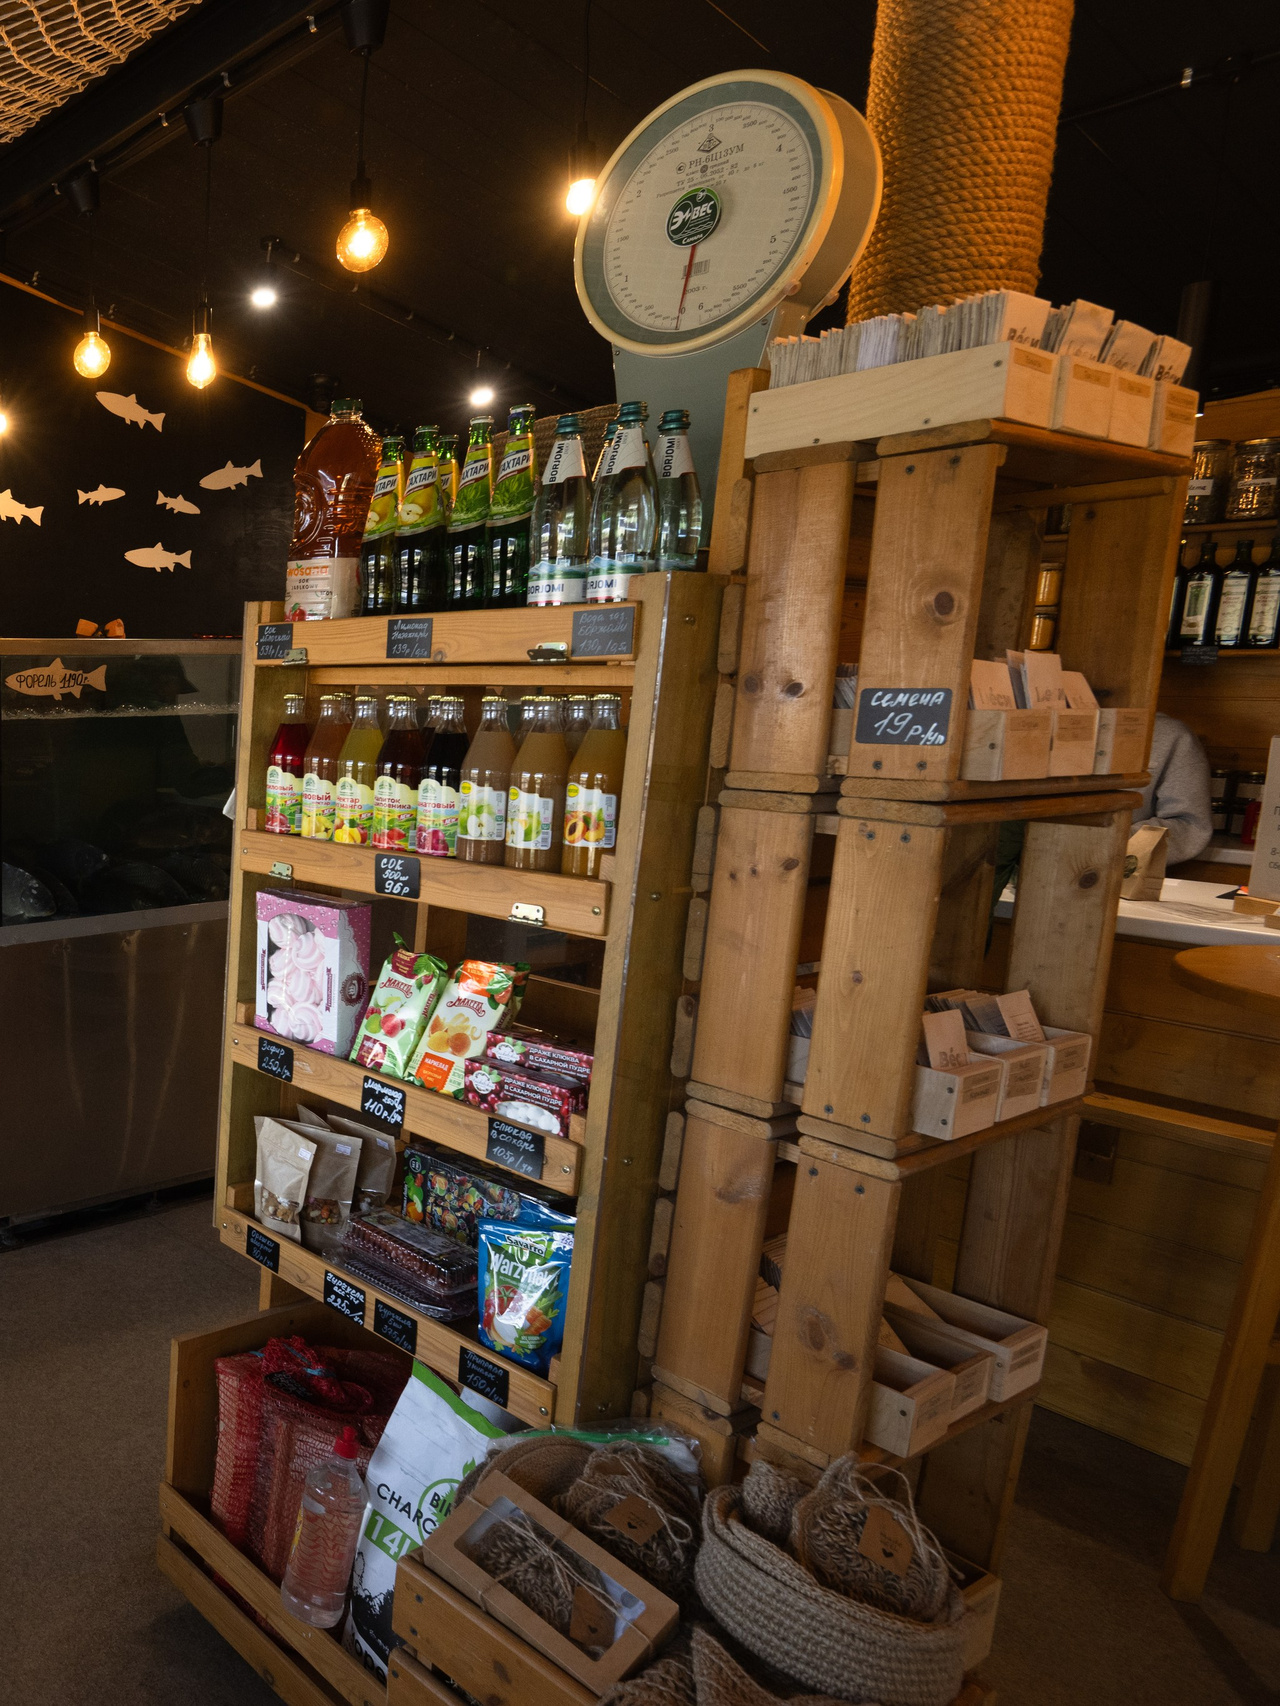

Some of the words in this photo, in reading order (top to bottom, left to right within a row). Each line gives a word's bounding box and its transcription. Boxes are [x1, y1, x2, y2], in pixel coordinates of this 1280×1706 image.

[708, 124, 715, 132] 3
[775, 143, 783, 152] 4
[636, 189, 642, 198] 2
[770, 235, 777, 243] 5
[624, 275, 629, 283] 1
[698, 303, 704, 311] 6
[606, 432, 624, 475] BORJOMI
[663, 437, 676, 478] BORJOMI
[549, 443, 565, 483] BORJOMI
[394, 620, 428, 633] Лимонад
[380, 857, 405, 871] СОК
[261, 1039, 285, 1059] Зефир
[552, 1050, 580, 1064] КЛЮКВА
[503, 1077, 526, 1089] ДРАЖЕ
[526, 1081, 553, 1096] КЛЮКВА
[542, 1093, 564, 1107] ПУДРЕ
[506, 1235, 545, 1256] Savarro
